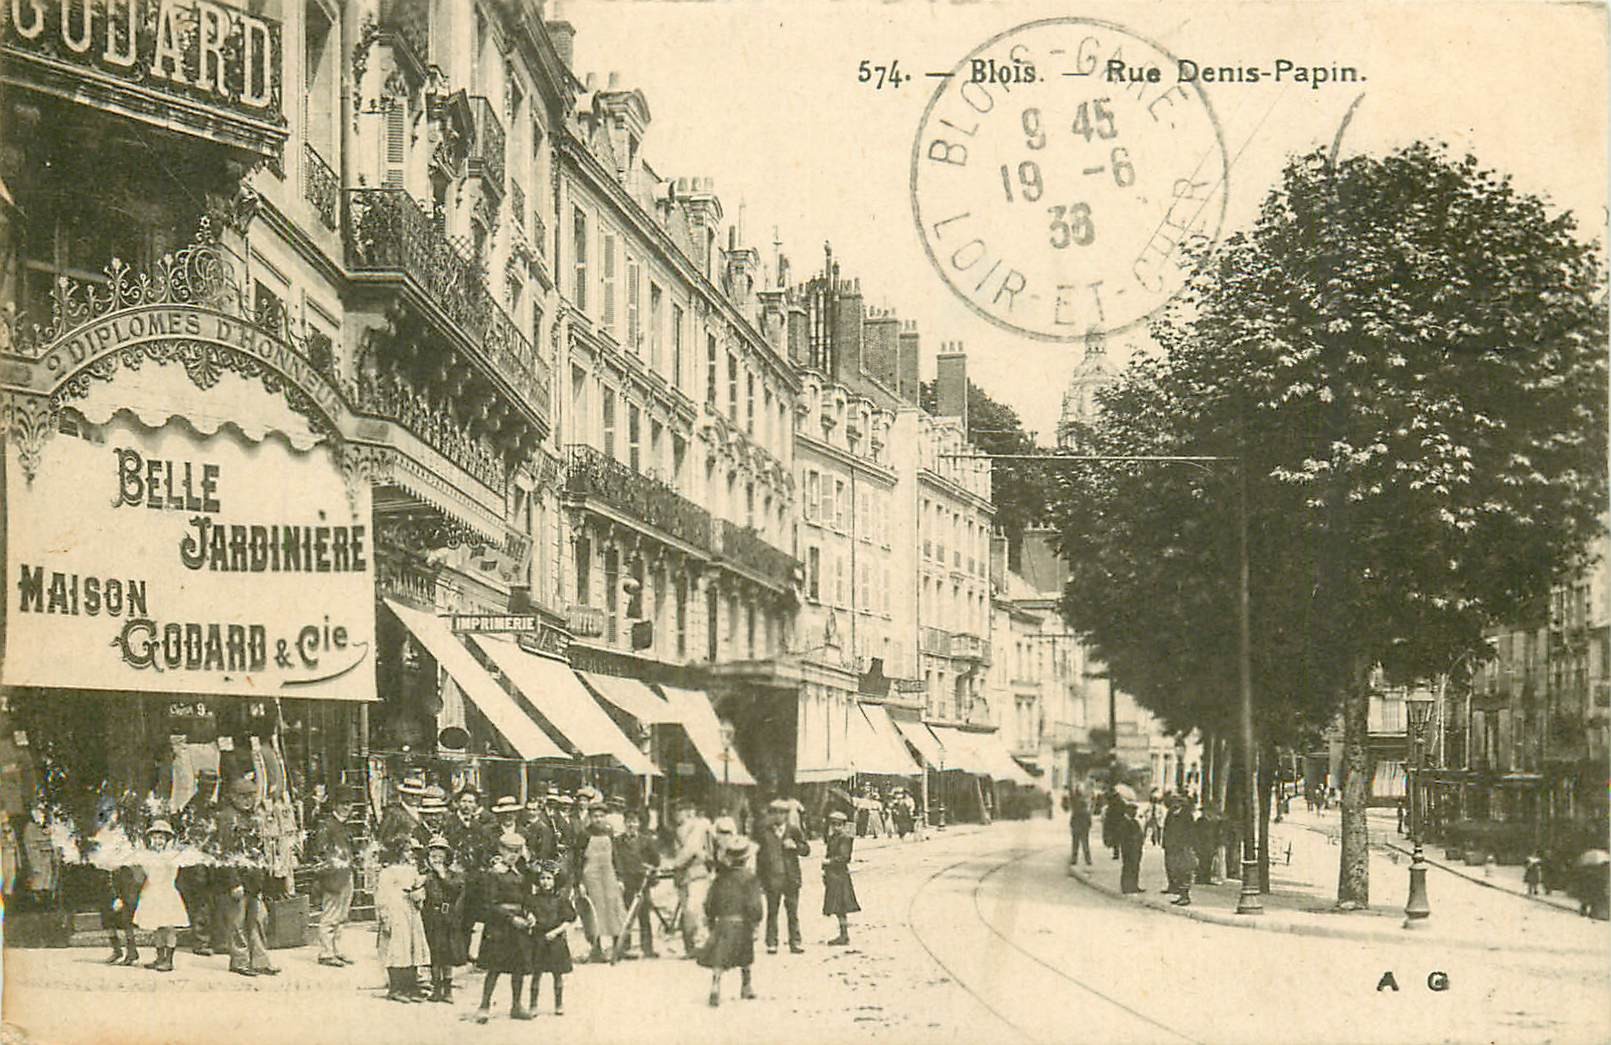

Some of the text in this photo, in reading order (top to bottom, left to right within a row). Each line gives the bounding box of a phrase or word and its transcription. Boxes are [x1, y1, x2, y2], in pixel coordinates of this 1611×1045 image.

[12, 0, 272, 108] GODARD
[66, 313, 201, 364] DIPLOMES
[112, 447, 220, 513] BELLE
[18, 564, 148, 617] MAISON
[111, 615, 349, 672] GODARD & Cie
[456, 616, 535, 631] IMPRIMERIE
